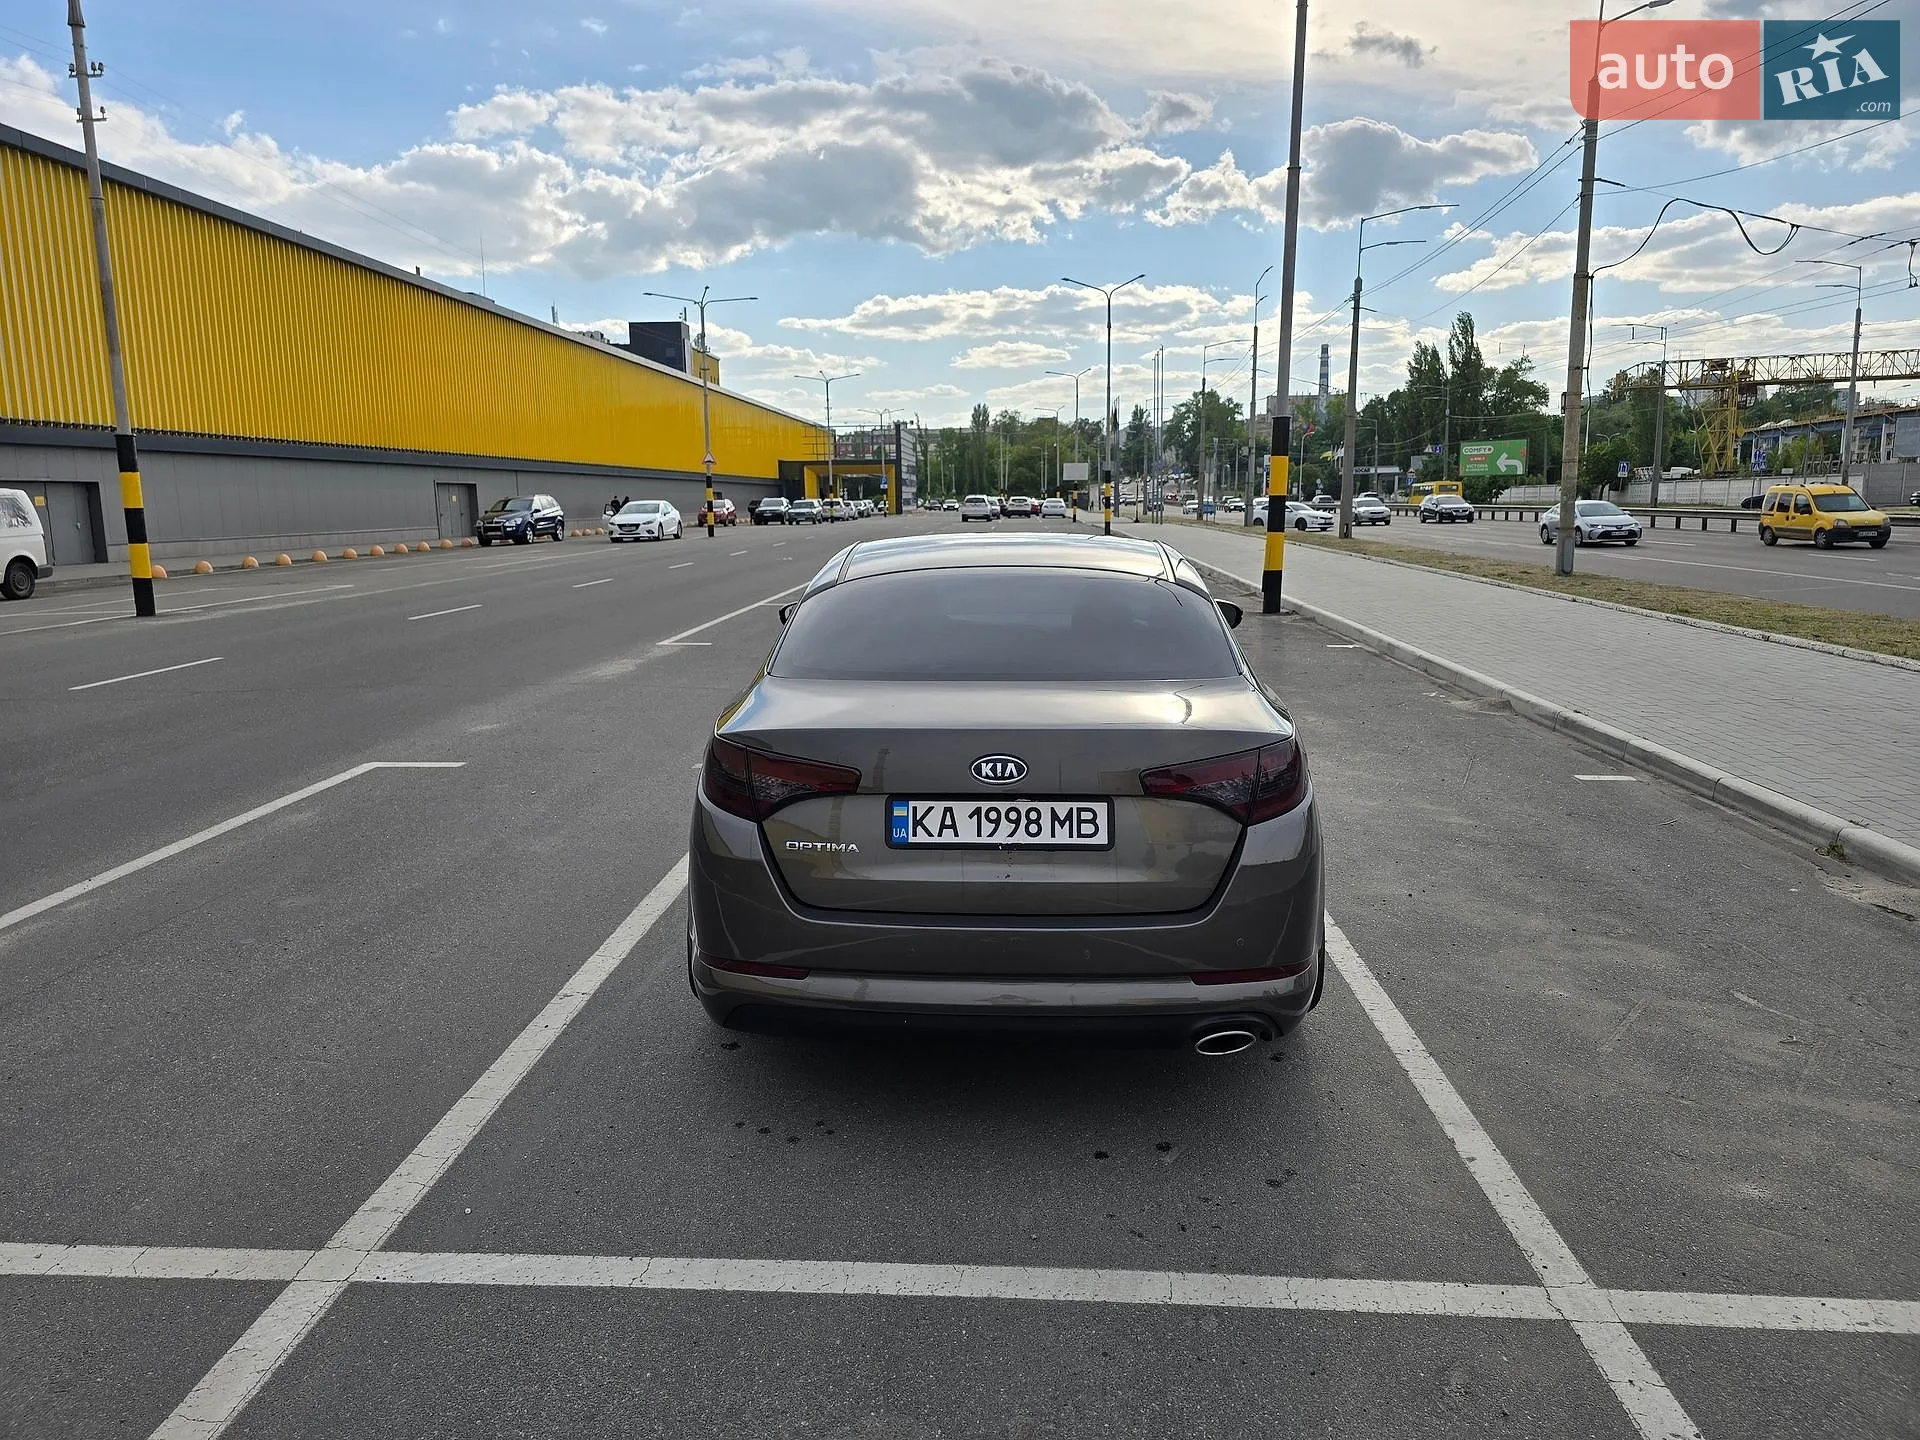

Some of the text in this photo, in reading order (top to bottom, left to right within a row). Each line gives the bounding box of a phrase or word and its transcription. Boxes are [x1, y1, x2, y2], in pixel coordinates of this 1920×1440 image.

[980, 762, 1018, 777] KIA
[912, 806, 1100, 839] KA 1998 MB
[893, 828, 907, 838] UA
[785, 841, 860, 853] OPTIMA
